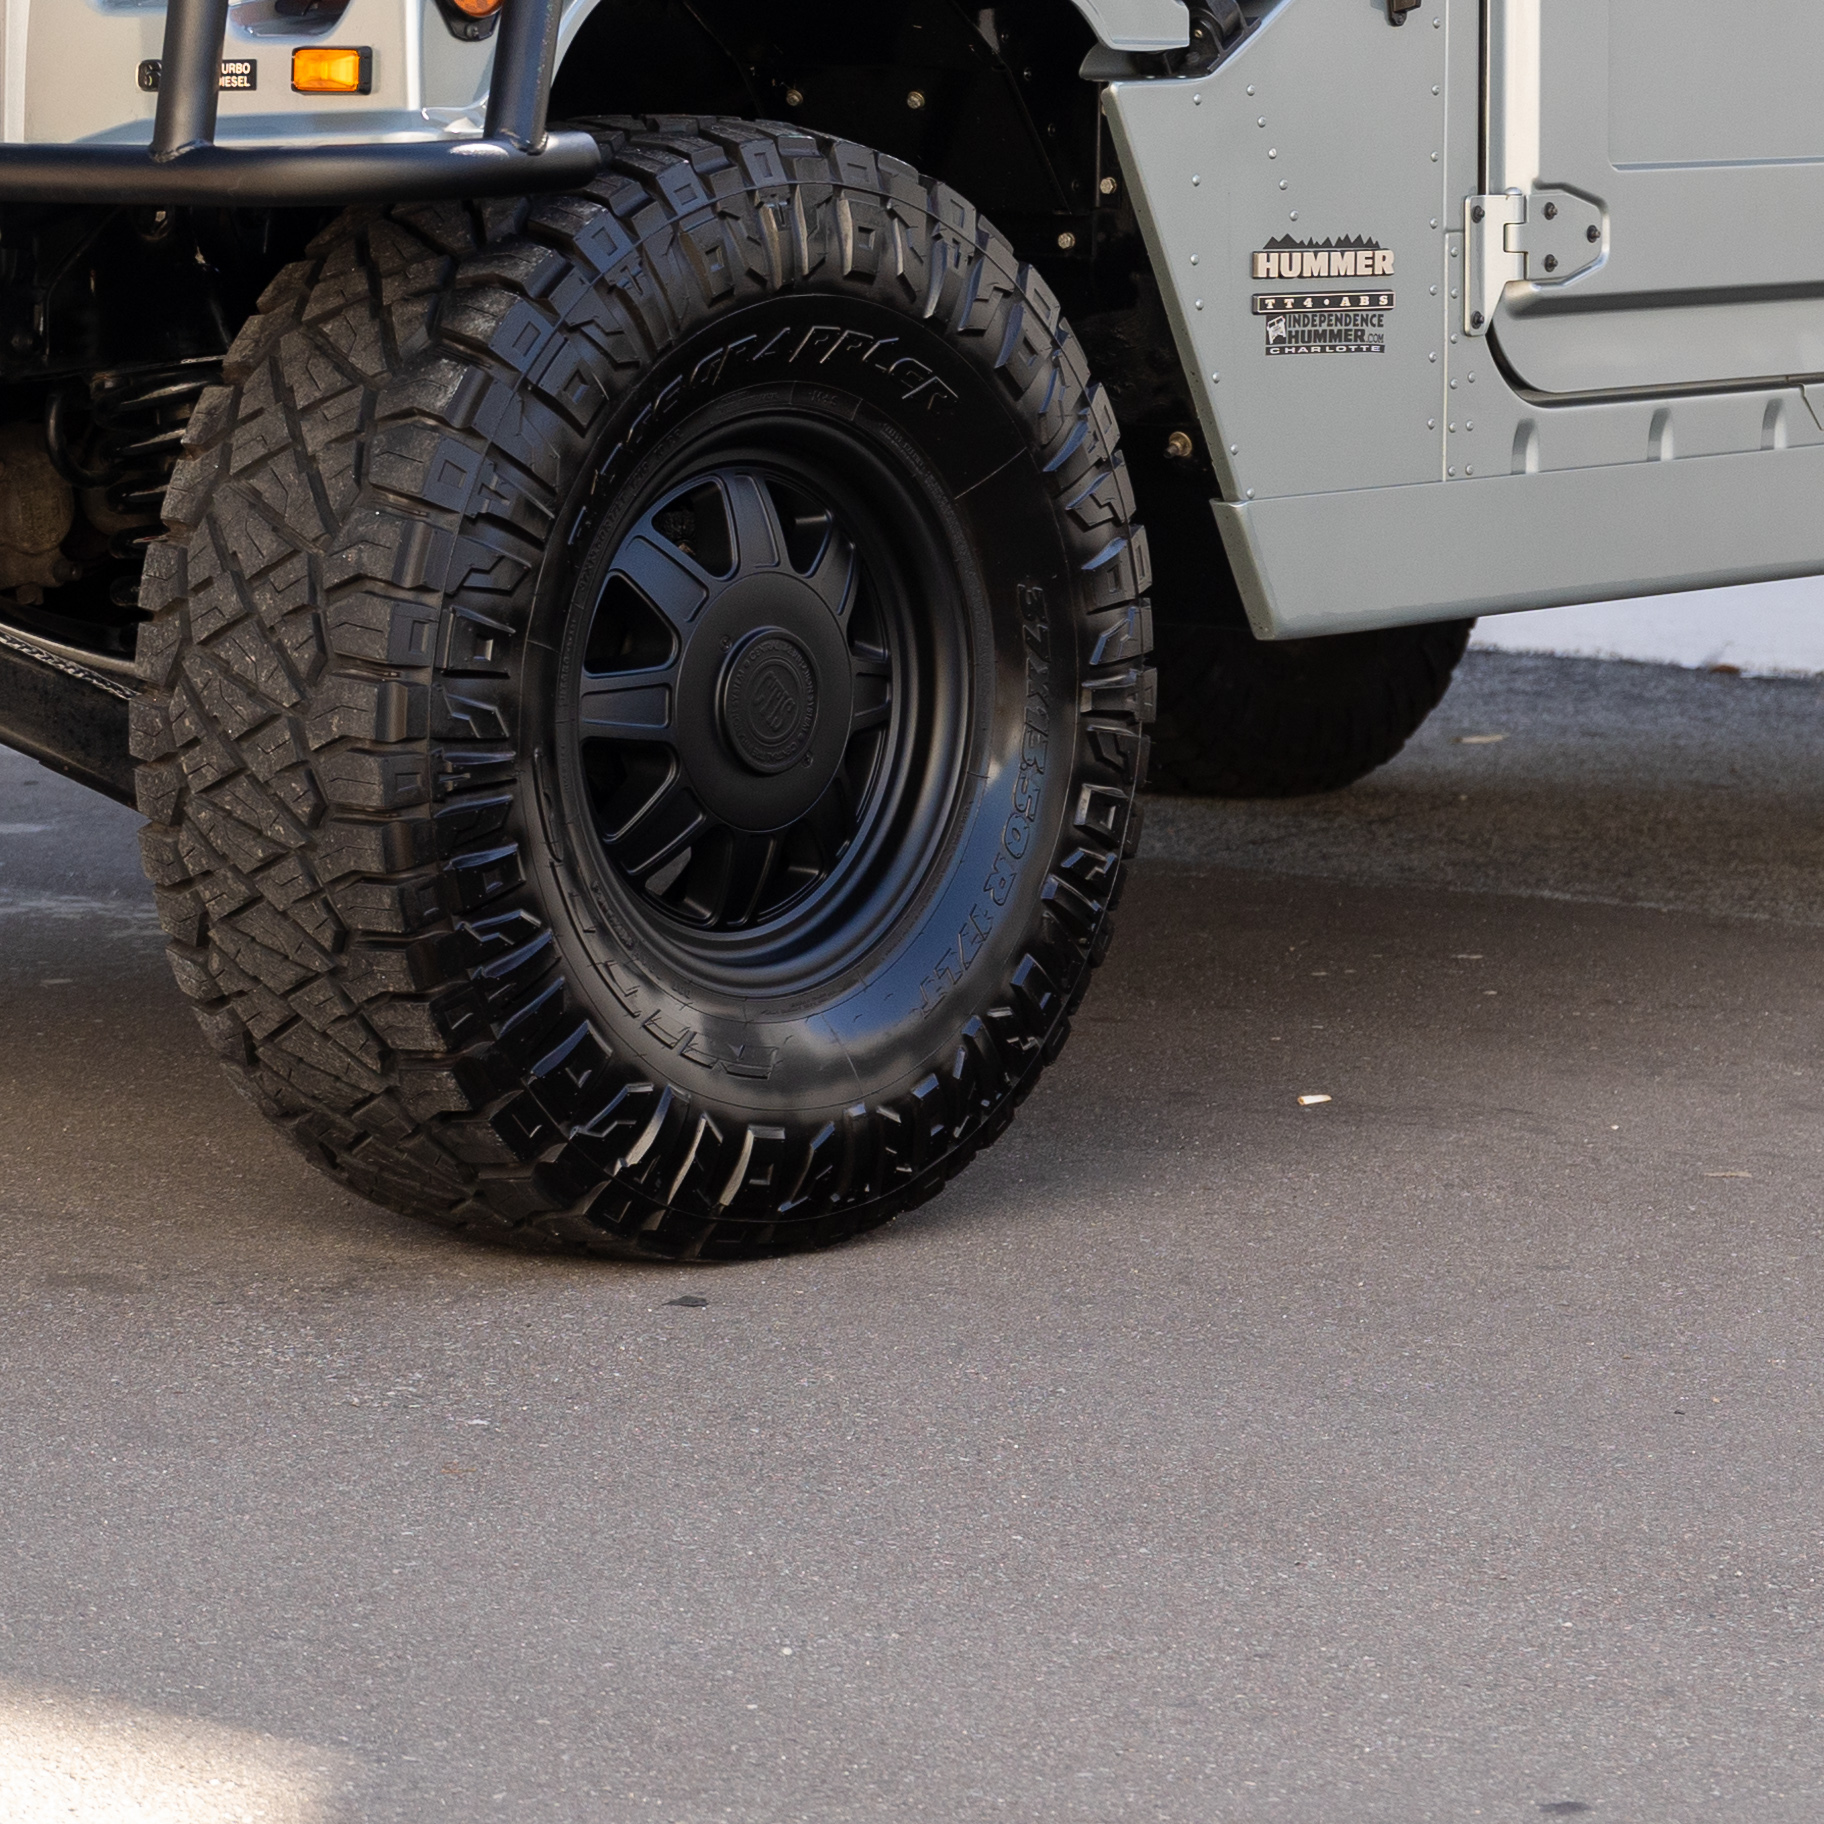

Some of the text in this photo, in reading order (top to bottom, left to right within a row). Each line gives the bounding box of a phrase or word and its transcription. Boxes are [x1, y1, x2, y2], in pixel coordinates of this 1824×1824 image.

[220, 62, 251, 75] URBO
[1255, 249, 1395, 278] HUMMER
[1287, 313, 1385, 328] INDEPENDENCE
[1270, 345, 1381, 354] CHARLOTTE
